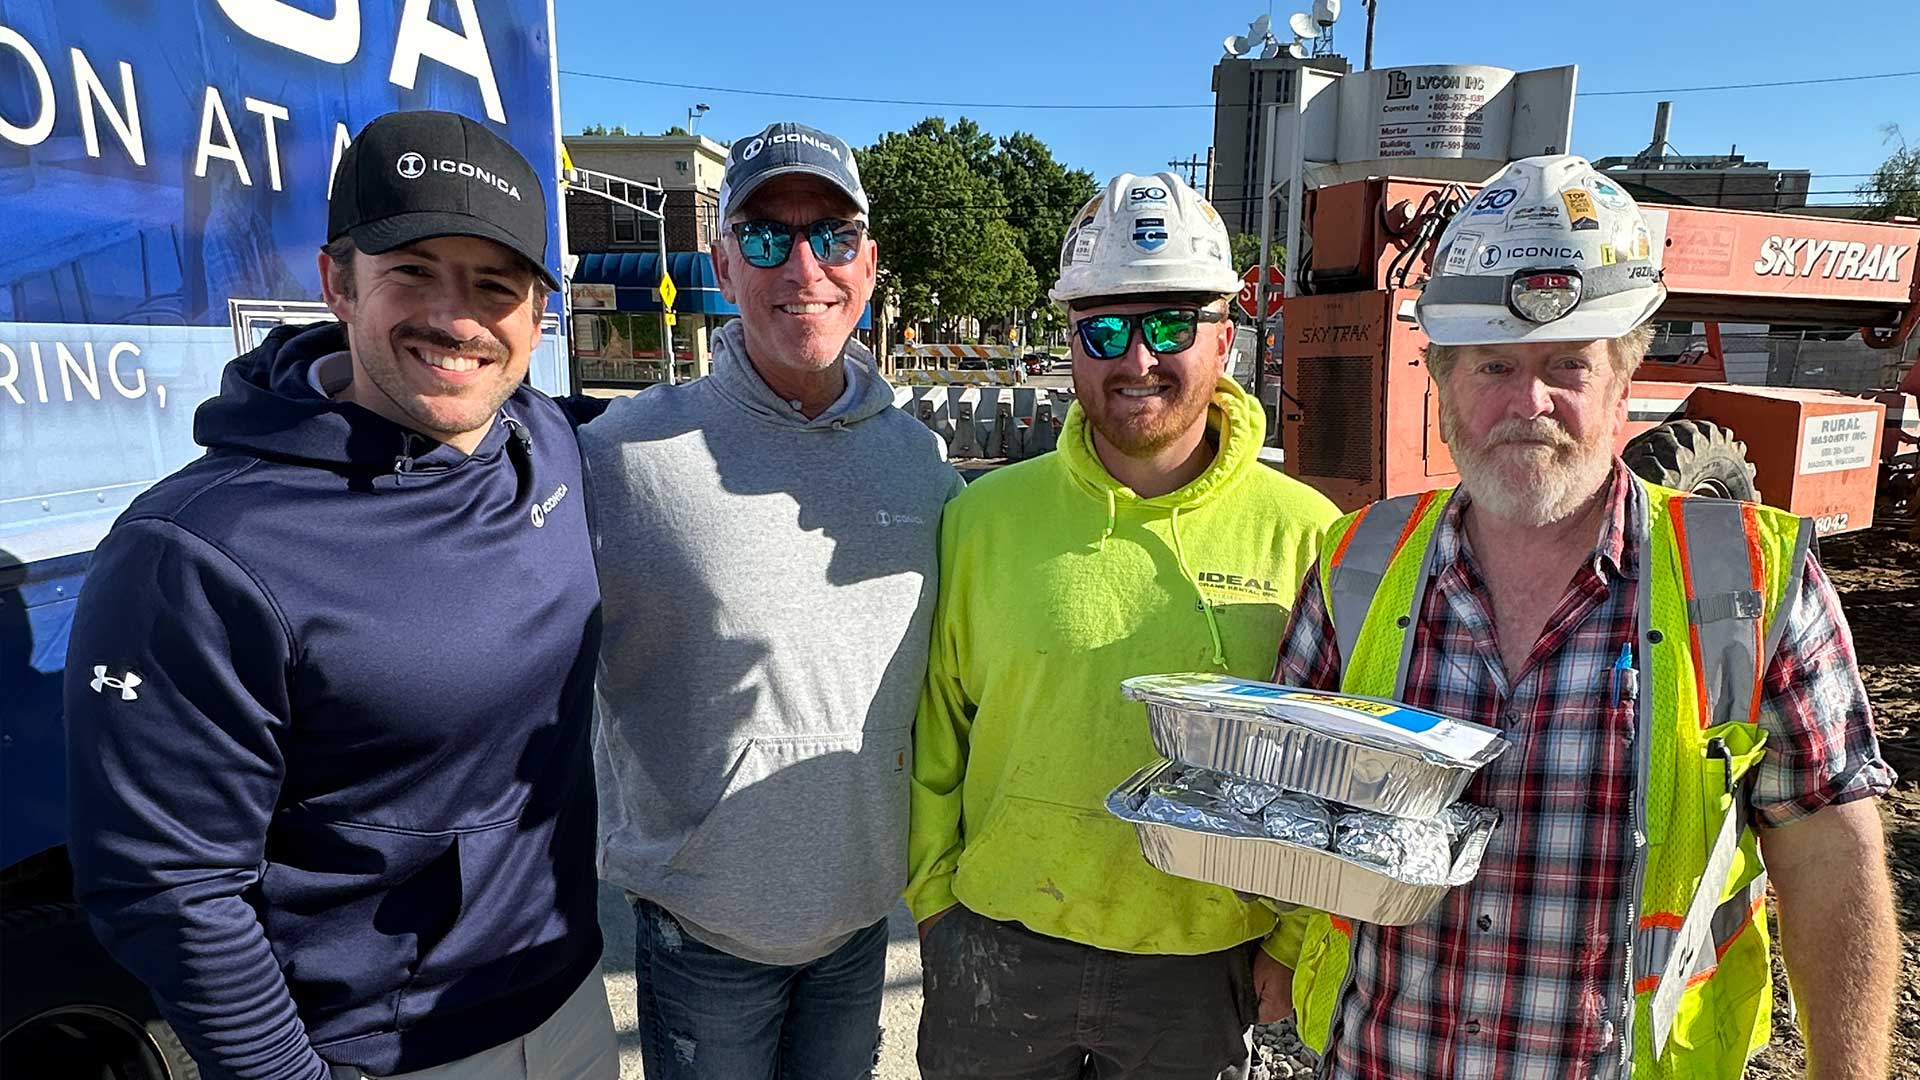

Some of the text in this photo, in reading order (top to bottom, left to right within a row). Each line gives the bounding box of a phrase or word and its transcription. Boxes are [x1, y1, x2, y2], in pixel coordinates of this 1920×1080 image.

[1416, 75, 1460, 90] LYCON
[1383, 104, 1419, 112] Concrete
[1381, 127, 1409, 135] Mortar
[194, 86, 290, 192] AT
[1380, 140, 1412, 149] Building
[768, 133, 842, 162] ICONICA
[1379, 148, 1416, 157] Materials
[433, 159, 521, 201] ICONICA
[1476, 189, 1518, 210] 50
[1566, 192, 1586, 200] TOP
[1506, 246, 1585, 261] ICONICA
[1754, 235, 1911, 282] SKYTRAK
[1821, 417, 1861, 433] RURAL
[1811, 433, 1850, 445] MASONRY
[541, 483, 569, 515] ICONICA
[1199, 572, 1278, 592] IDEAL
[1199, 582, 1226, 590] CRANE
